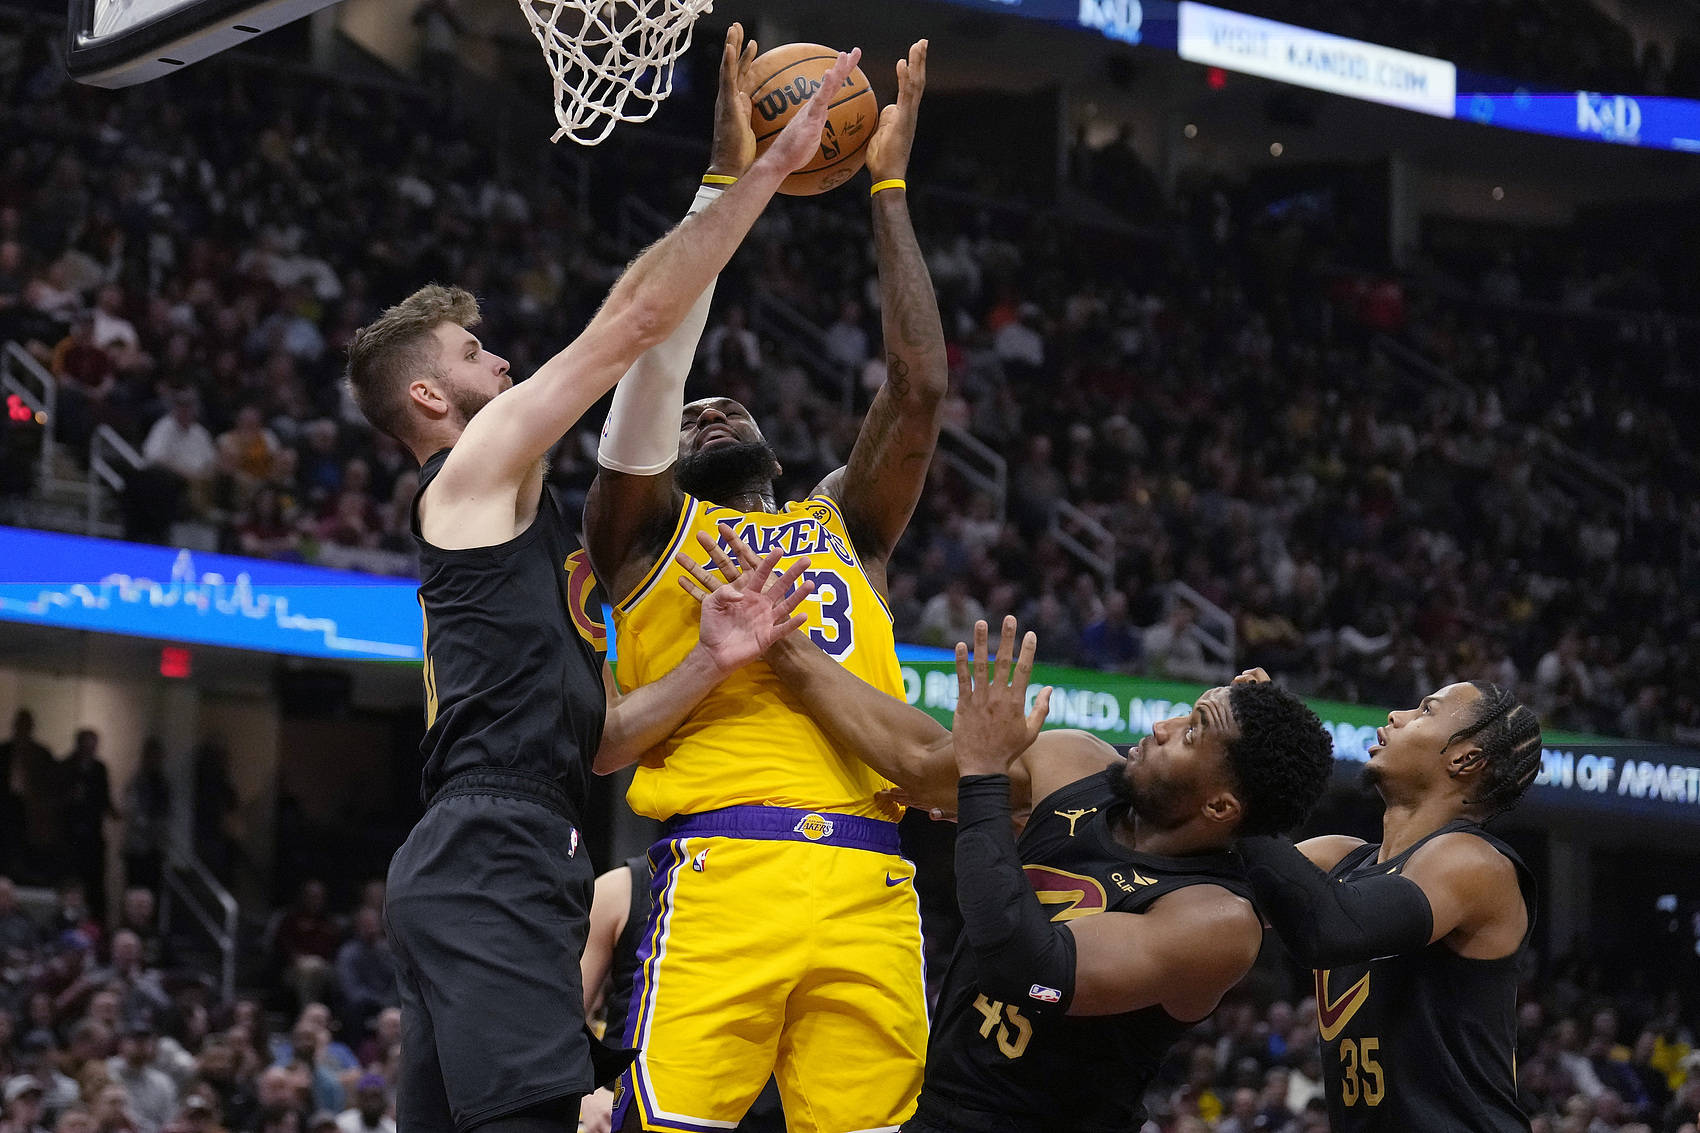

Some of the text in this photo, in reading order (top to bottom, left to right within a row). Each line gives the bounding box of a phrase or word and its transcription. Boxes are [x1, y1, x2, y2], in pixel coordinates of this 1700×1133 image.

[755, 75, 854, 121] Wilsn
[1576, 754, 1616, 793] OF
[1111, 872, 1136, 893] CLIF
[972, 992, 1033, 1059] 45
[1340, 1037, 1385, 1107] 35
